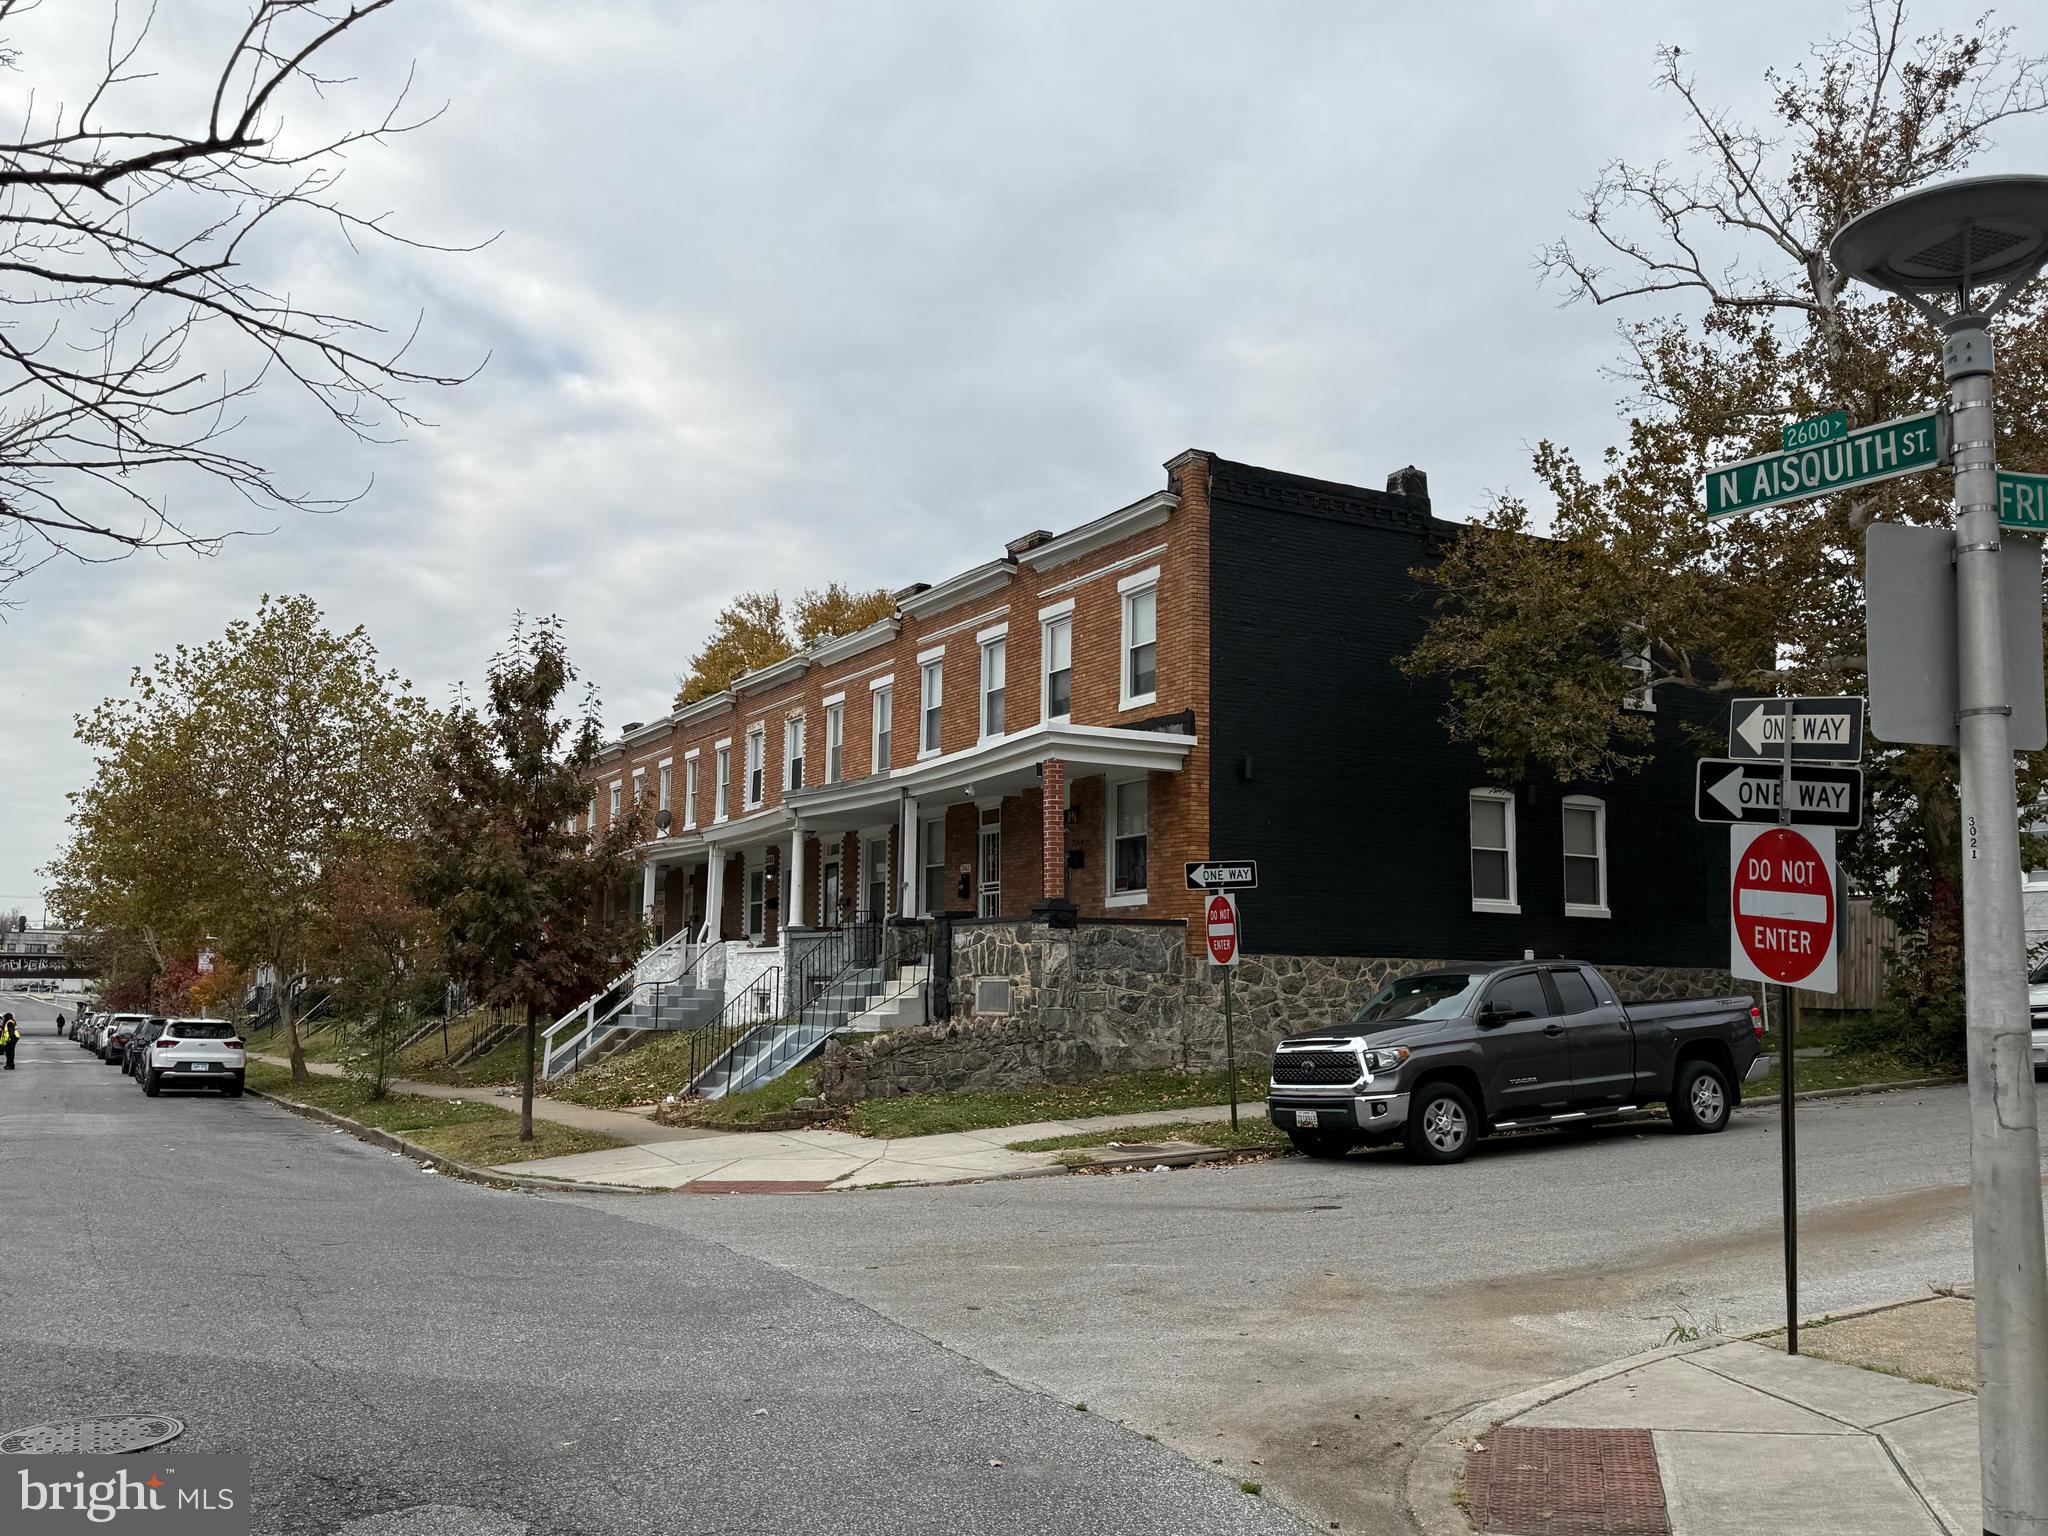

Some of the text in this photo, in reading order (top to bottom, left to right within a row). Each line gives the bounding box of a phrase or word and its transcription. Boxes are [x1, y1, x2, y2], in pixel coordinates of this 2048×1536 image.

[1787, 418, 1831, 448] 2600
[1752, 430, 1898, 501] AISQUITH
[1902, 428, 1931, 456] ST.
[2000, 480, 2045, 522] FRI
[1802, 717, 1845, 741] WAY
[1799, 784, 1846, 809] WAY
[1968, 816, 1977, 859] 3021
[1203, 869, 1249, 880] ONE WAY
[1748, 858, 1816, 885] DO NOT
[1210, 909, 1230, 920] DO NOT
[1214, 940, 1231, 950] ENTER
[1754, 925, 1812, 955] ENTER
